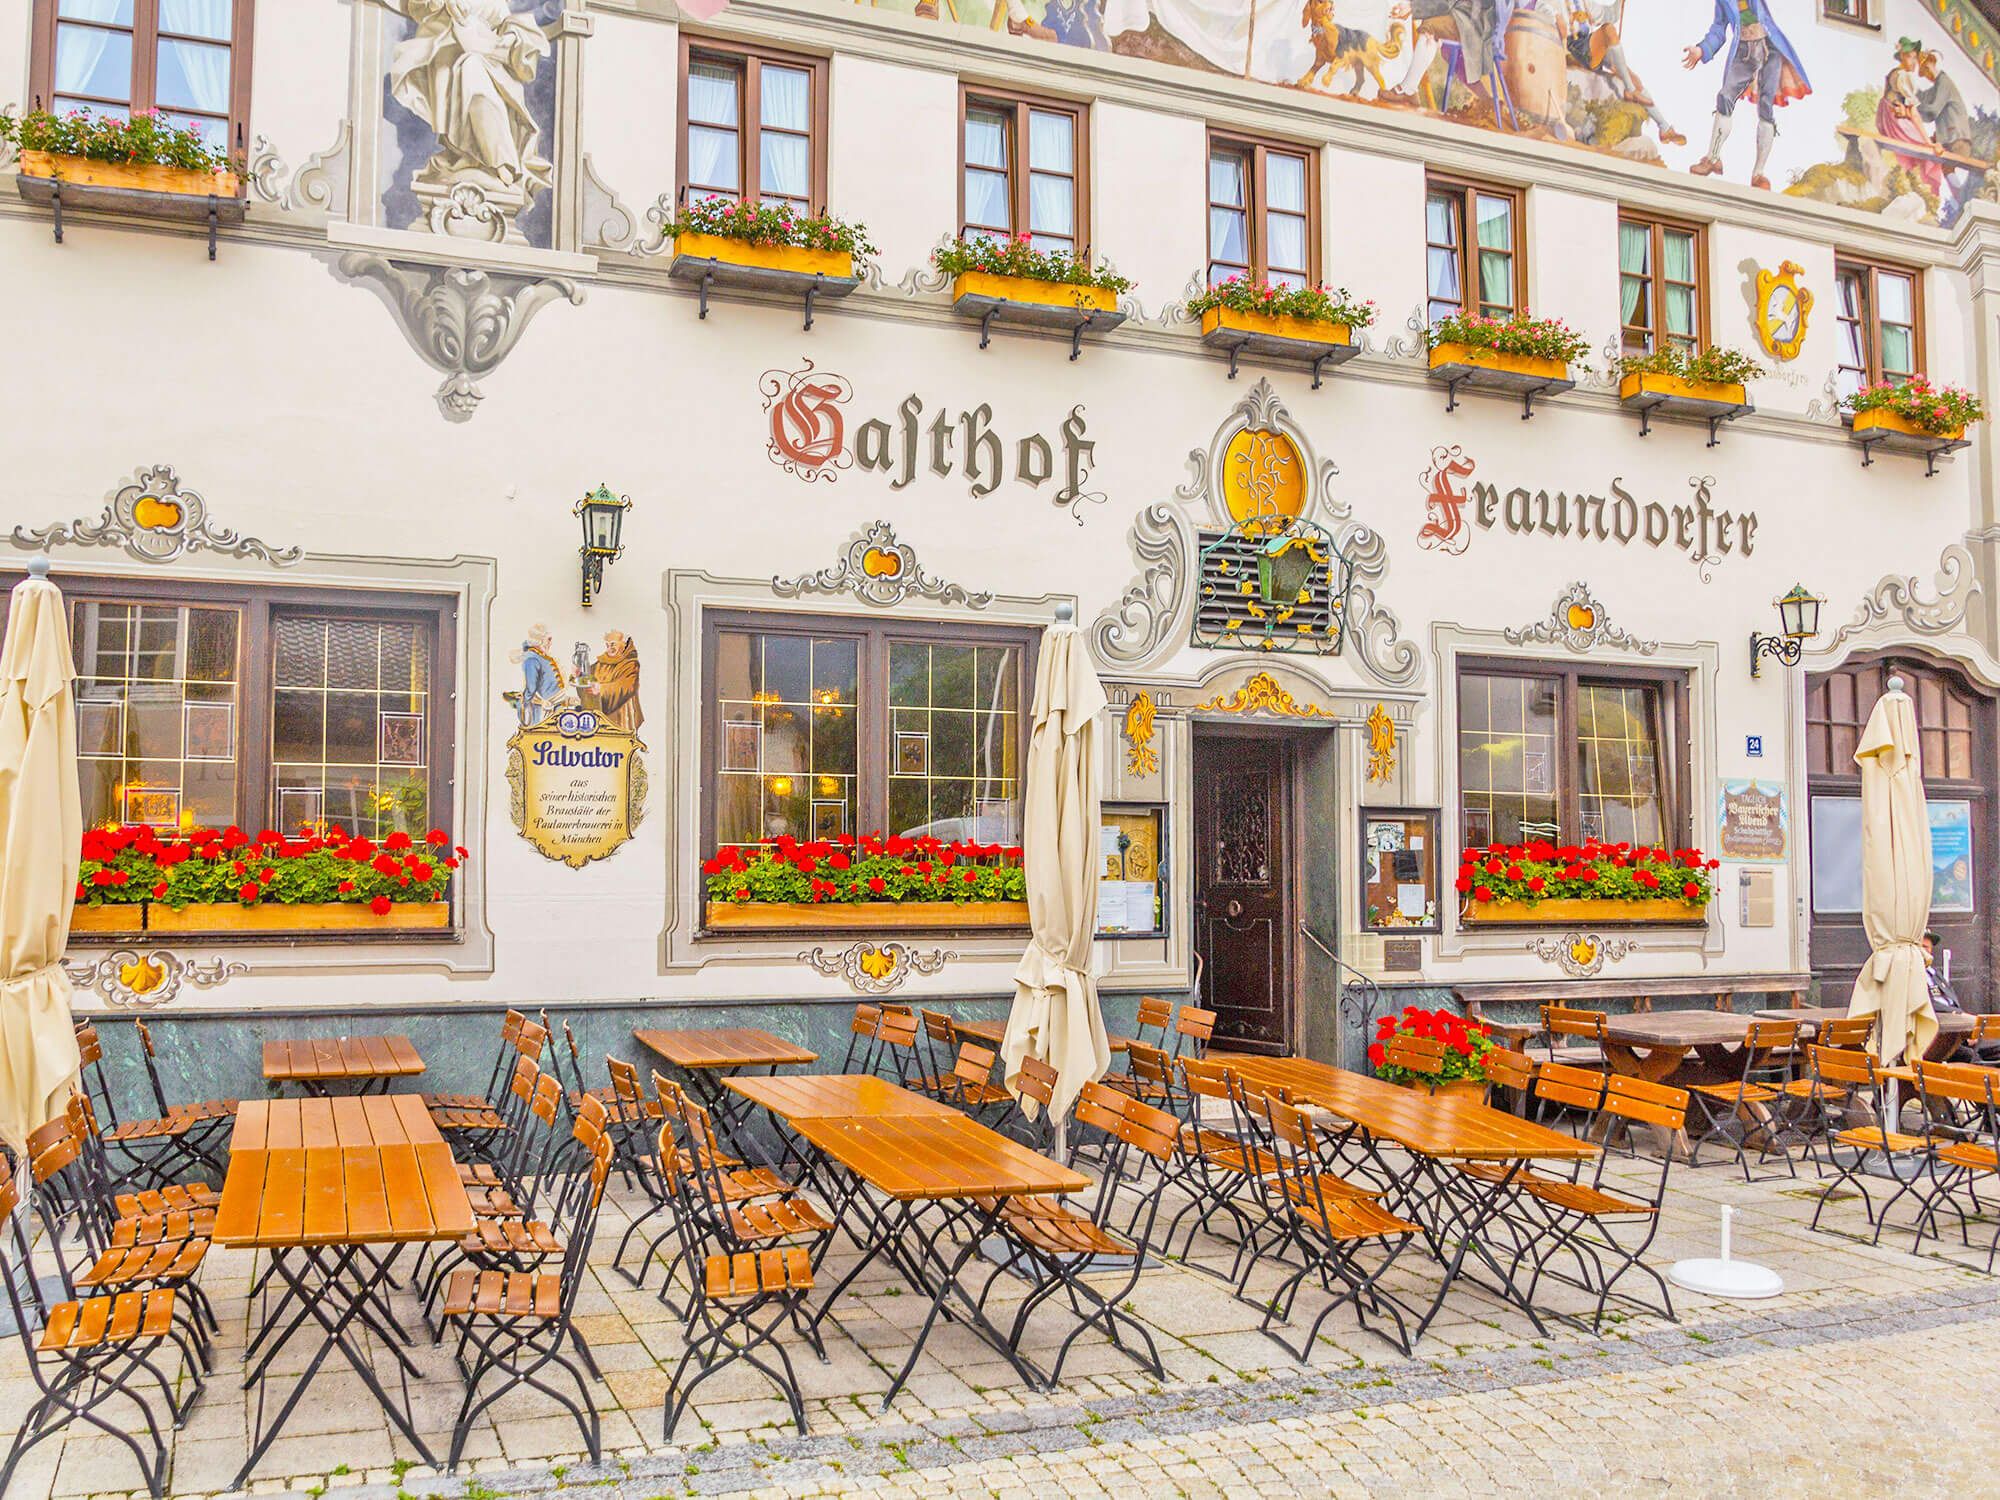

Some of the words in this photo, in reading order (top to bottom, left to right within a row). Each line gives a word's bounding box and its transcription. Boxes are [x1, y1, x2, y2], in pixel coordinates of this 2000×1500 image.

[1417, 447, 1758, 576] Fraundorfer
[1749, 739, 1760, 749] 24
[532, 740, 624, 768] Salvator
[570, 779, 589, 788] aus
[539, 790, 567, 802] seiner
[567, 790, 617, 802] historischen
[596, 805, 611, 816] der
[533, 817, 614, 829] Paulanerbrauerei
[614, 819, 623, 830] in
[551, 833, 602, 845] München
